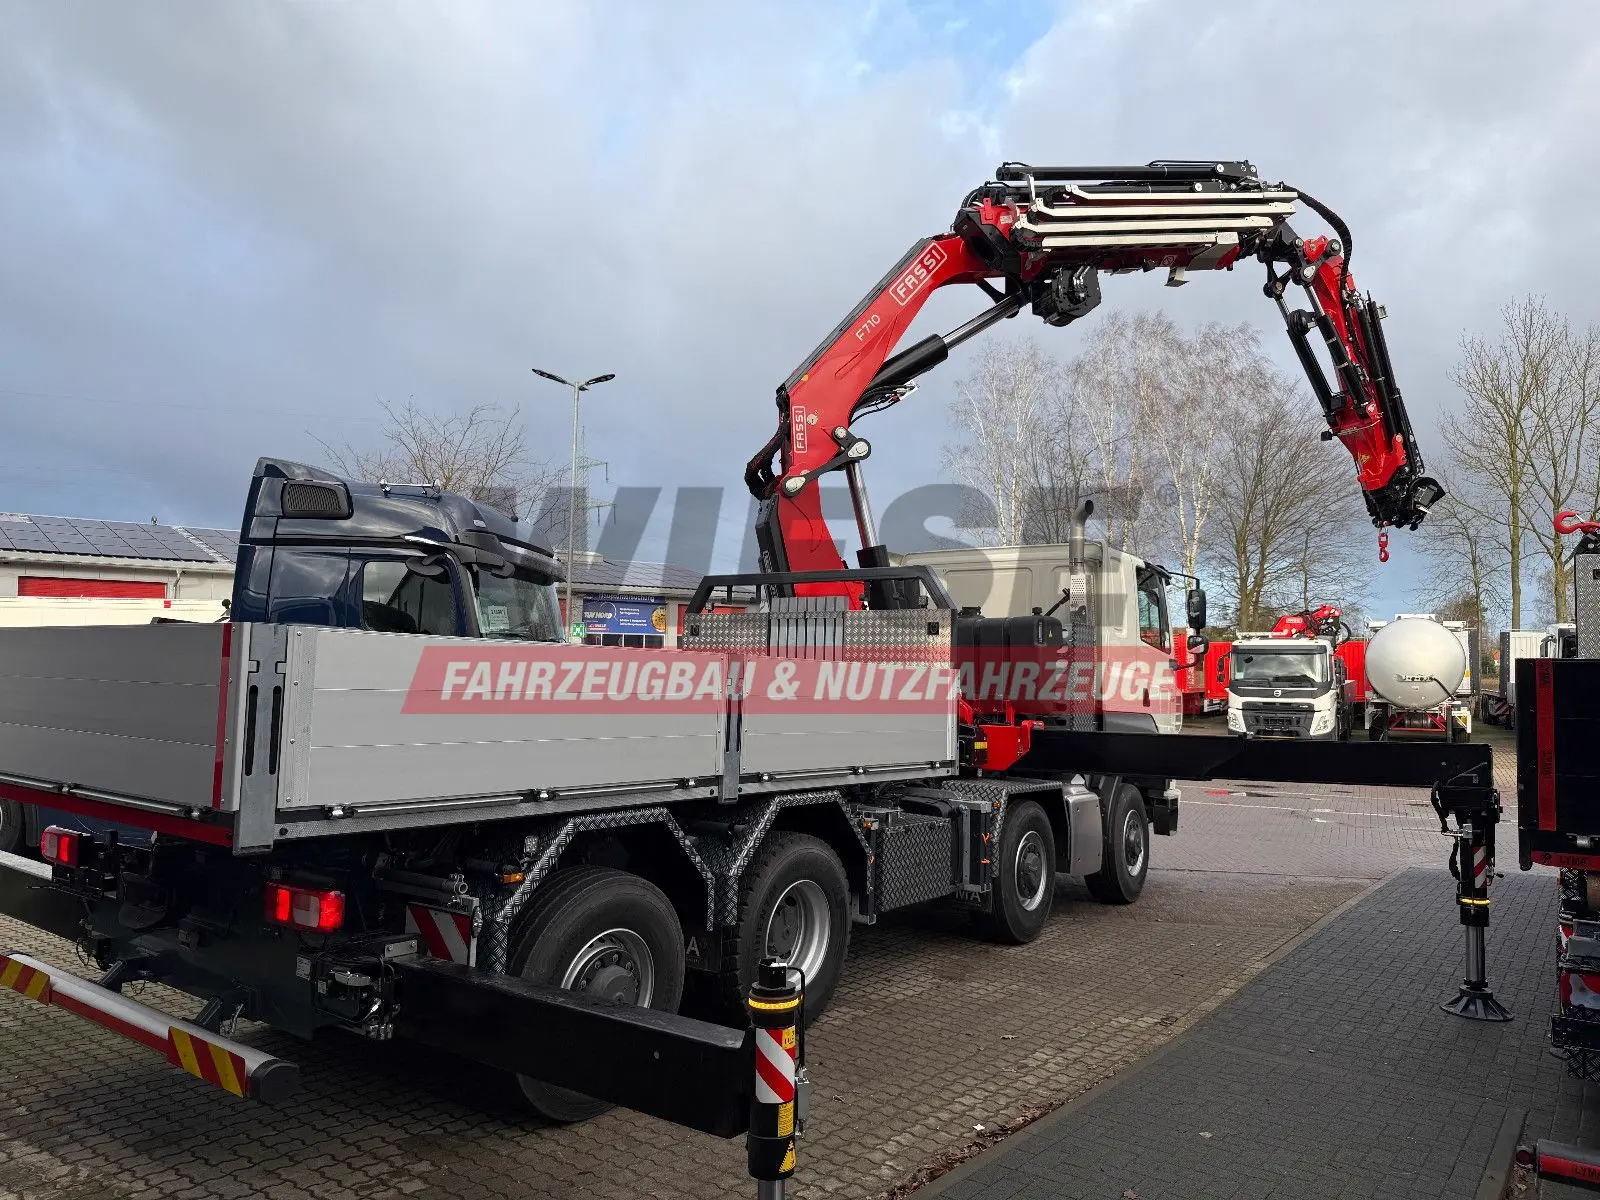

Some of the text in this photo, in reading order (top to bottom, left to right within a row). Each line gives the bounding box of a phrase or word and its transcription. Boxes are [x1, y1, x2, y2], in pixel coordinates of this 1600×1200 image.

[896, 248, 942, 299] FASSI
[855, 314, 881, 342] F710
[794, 410, 805, 450] FASSI
